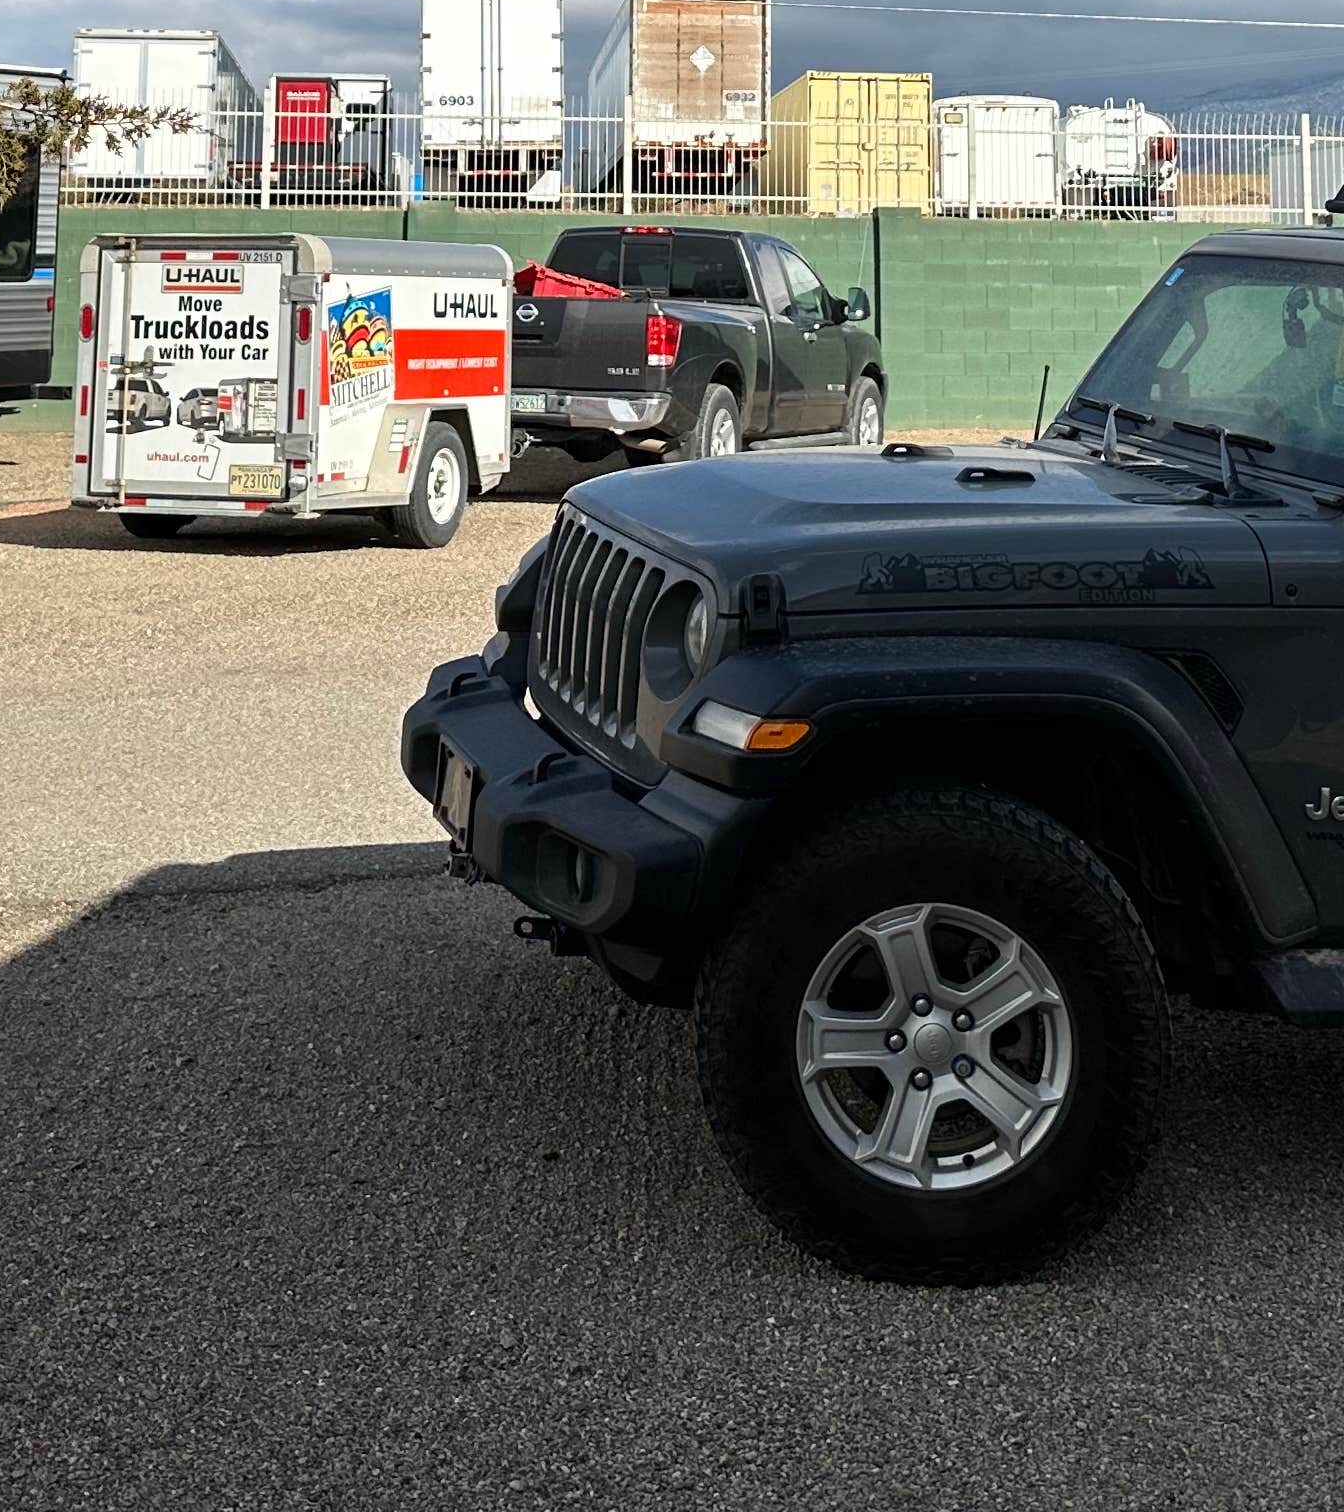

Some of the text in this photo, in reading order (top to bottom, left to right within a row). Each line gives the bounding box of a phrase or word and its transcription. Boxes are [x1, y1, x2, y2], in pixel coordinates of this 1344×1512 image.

[439, 95, 474, 106] 6903
[253, 252, 273, 262] 2151
[275, 252, 283, 262] D
[166, 268, 241, 283] U-HAUL
[178, 295, 222, 312] Move
[434, 292, 498, 319] U-HAUL
[131, 314, 269, 340] Truckloads
[159, 343, 269, 360] with Your Car
[331, 368, 391, 406] MITCHELL
[147, 451, 209, 463] uhaul.com
[231, 474, 281, 490] PT 231070
[923, 560, 1146, 590] BIGFOOT
[1079, 589, 1156, 602] EDITION
